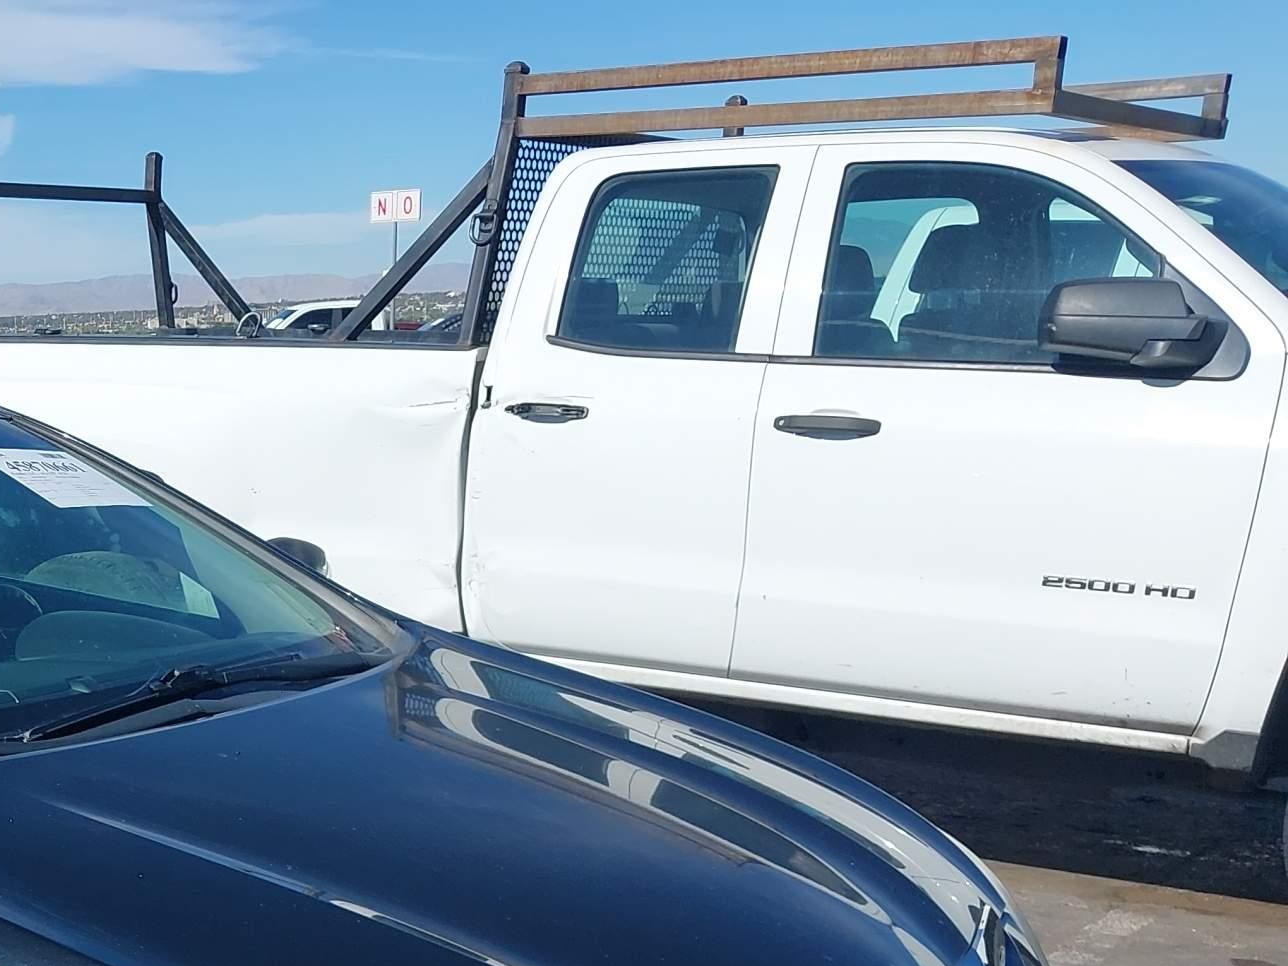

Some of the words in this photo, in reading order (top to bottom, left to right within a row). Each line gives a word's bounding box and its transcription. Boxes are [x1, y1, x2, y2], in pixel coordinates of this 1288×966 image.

[378, 198, 387, 216] N
[6, 461, 86, 473] 45870661
[1041, 576, 1136, 595] 2500
